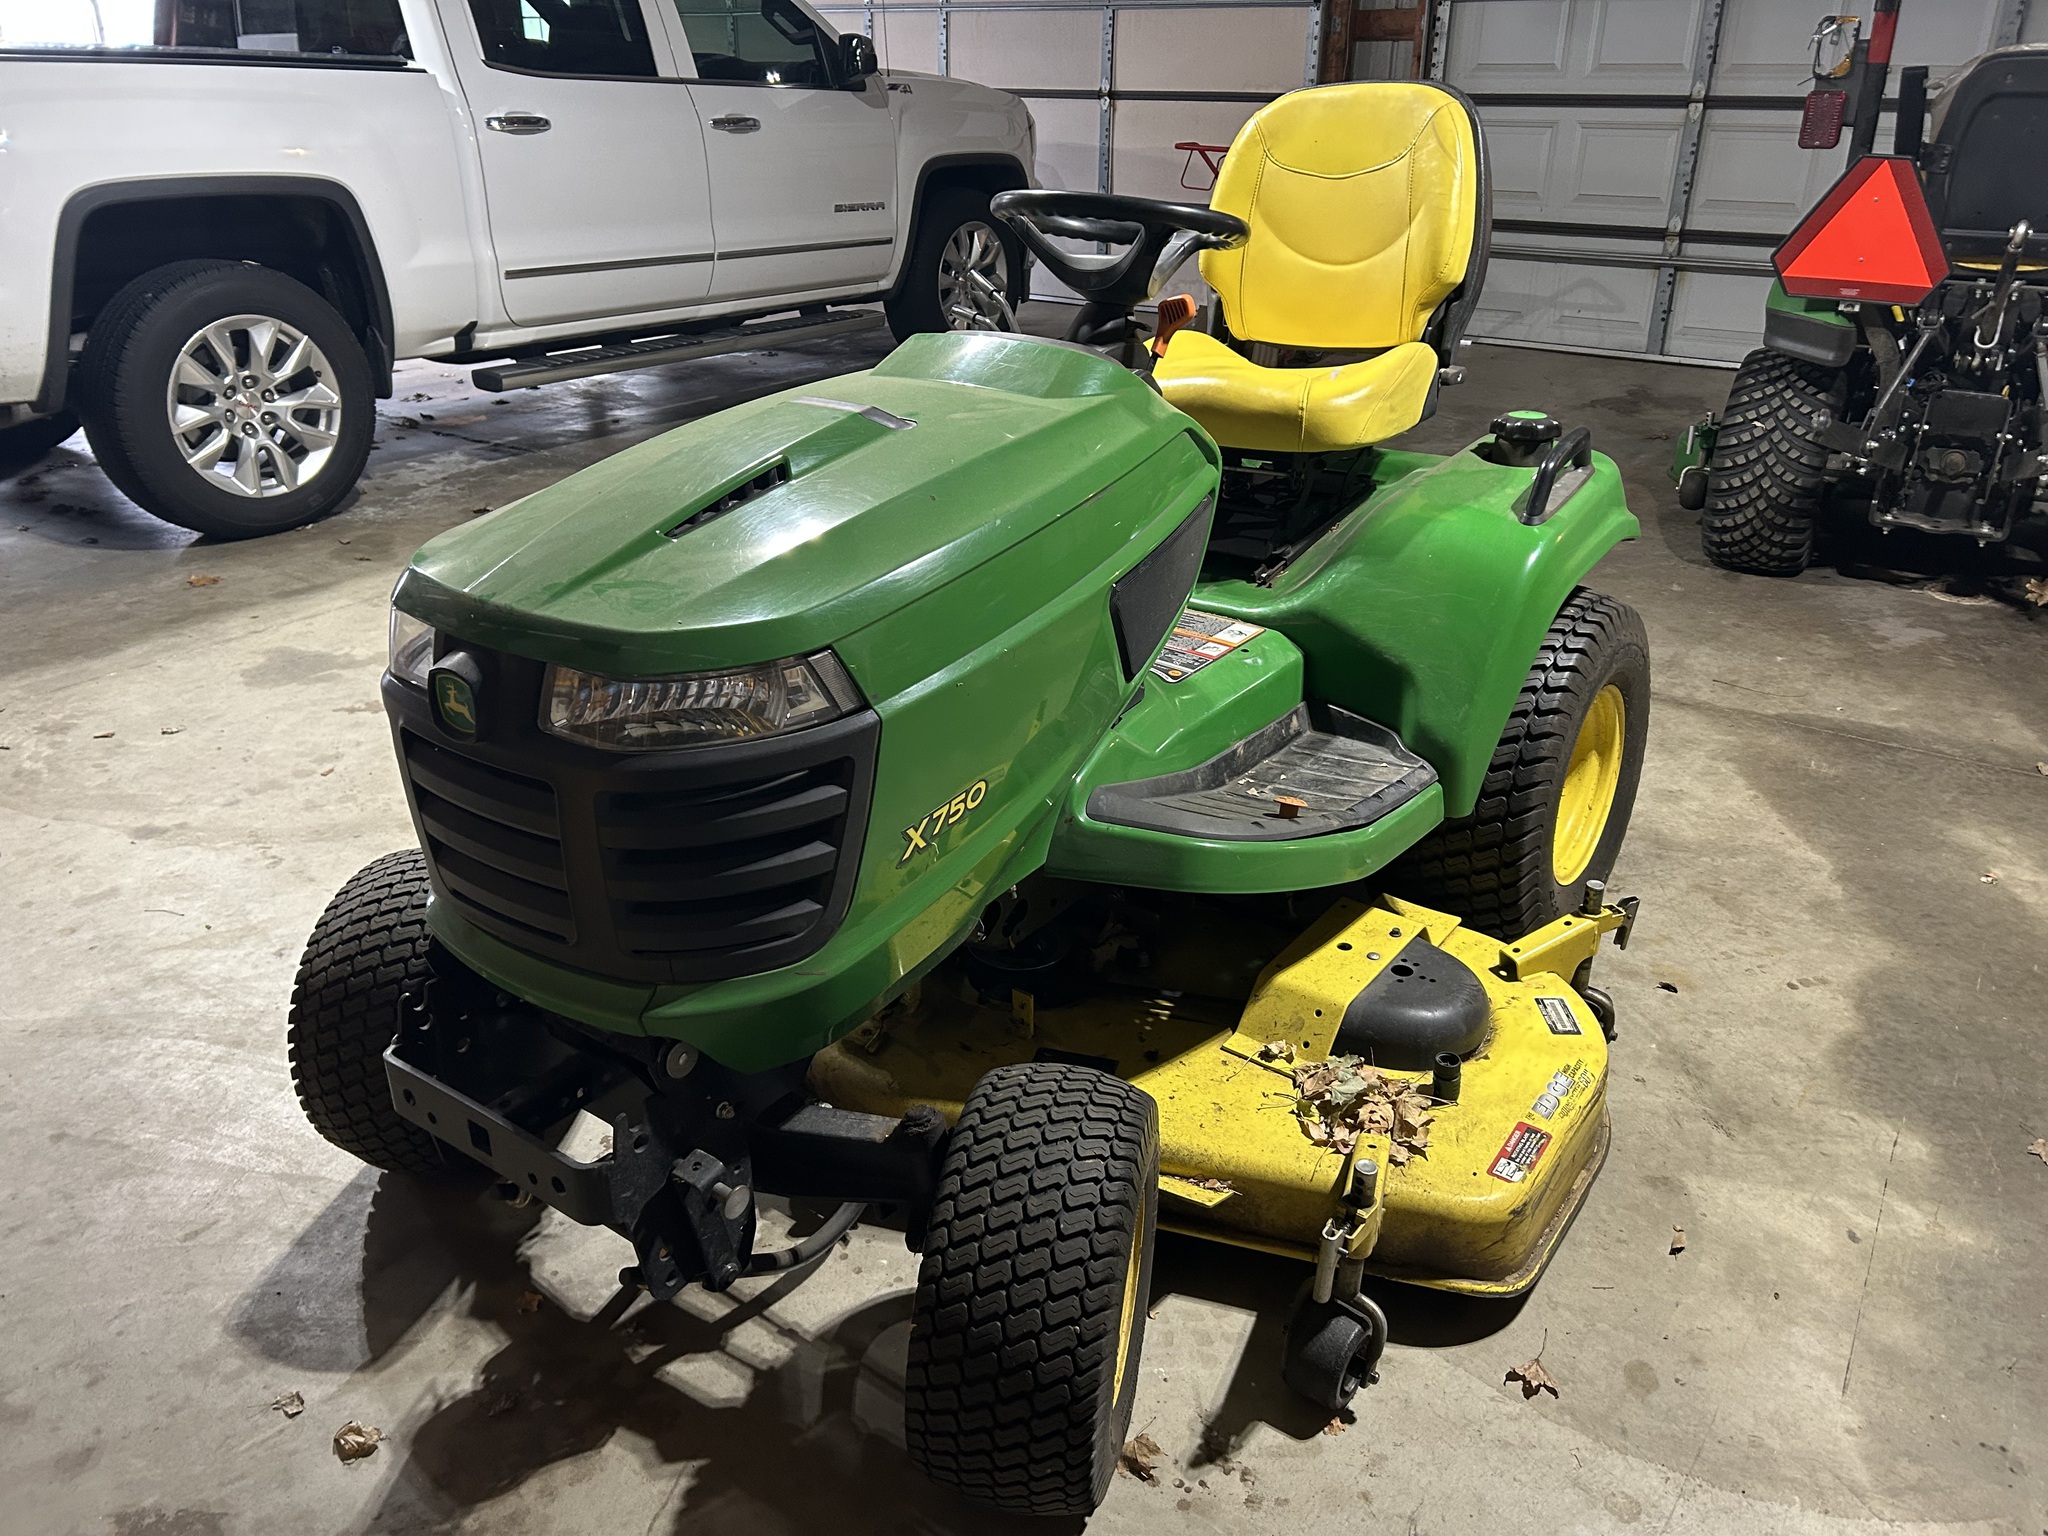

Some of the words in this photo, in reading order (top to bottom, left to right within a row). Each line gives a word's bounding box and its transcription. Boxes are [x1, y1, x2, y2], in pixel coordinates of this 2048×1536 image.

[834, 202, 886, 213] SIERRA
[898, 779, 987, 867] X750
[1568, 1058, 1584, 1079] CAPACITY
[1530, 1071, 1576, 1121] EDGE
[1506, 1130, 1522, 1148] DANGER
